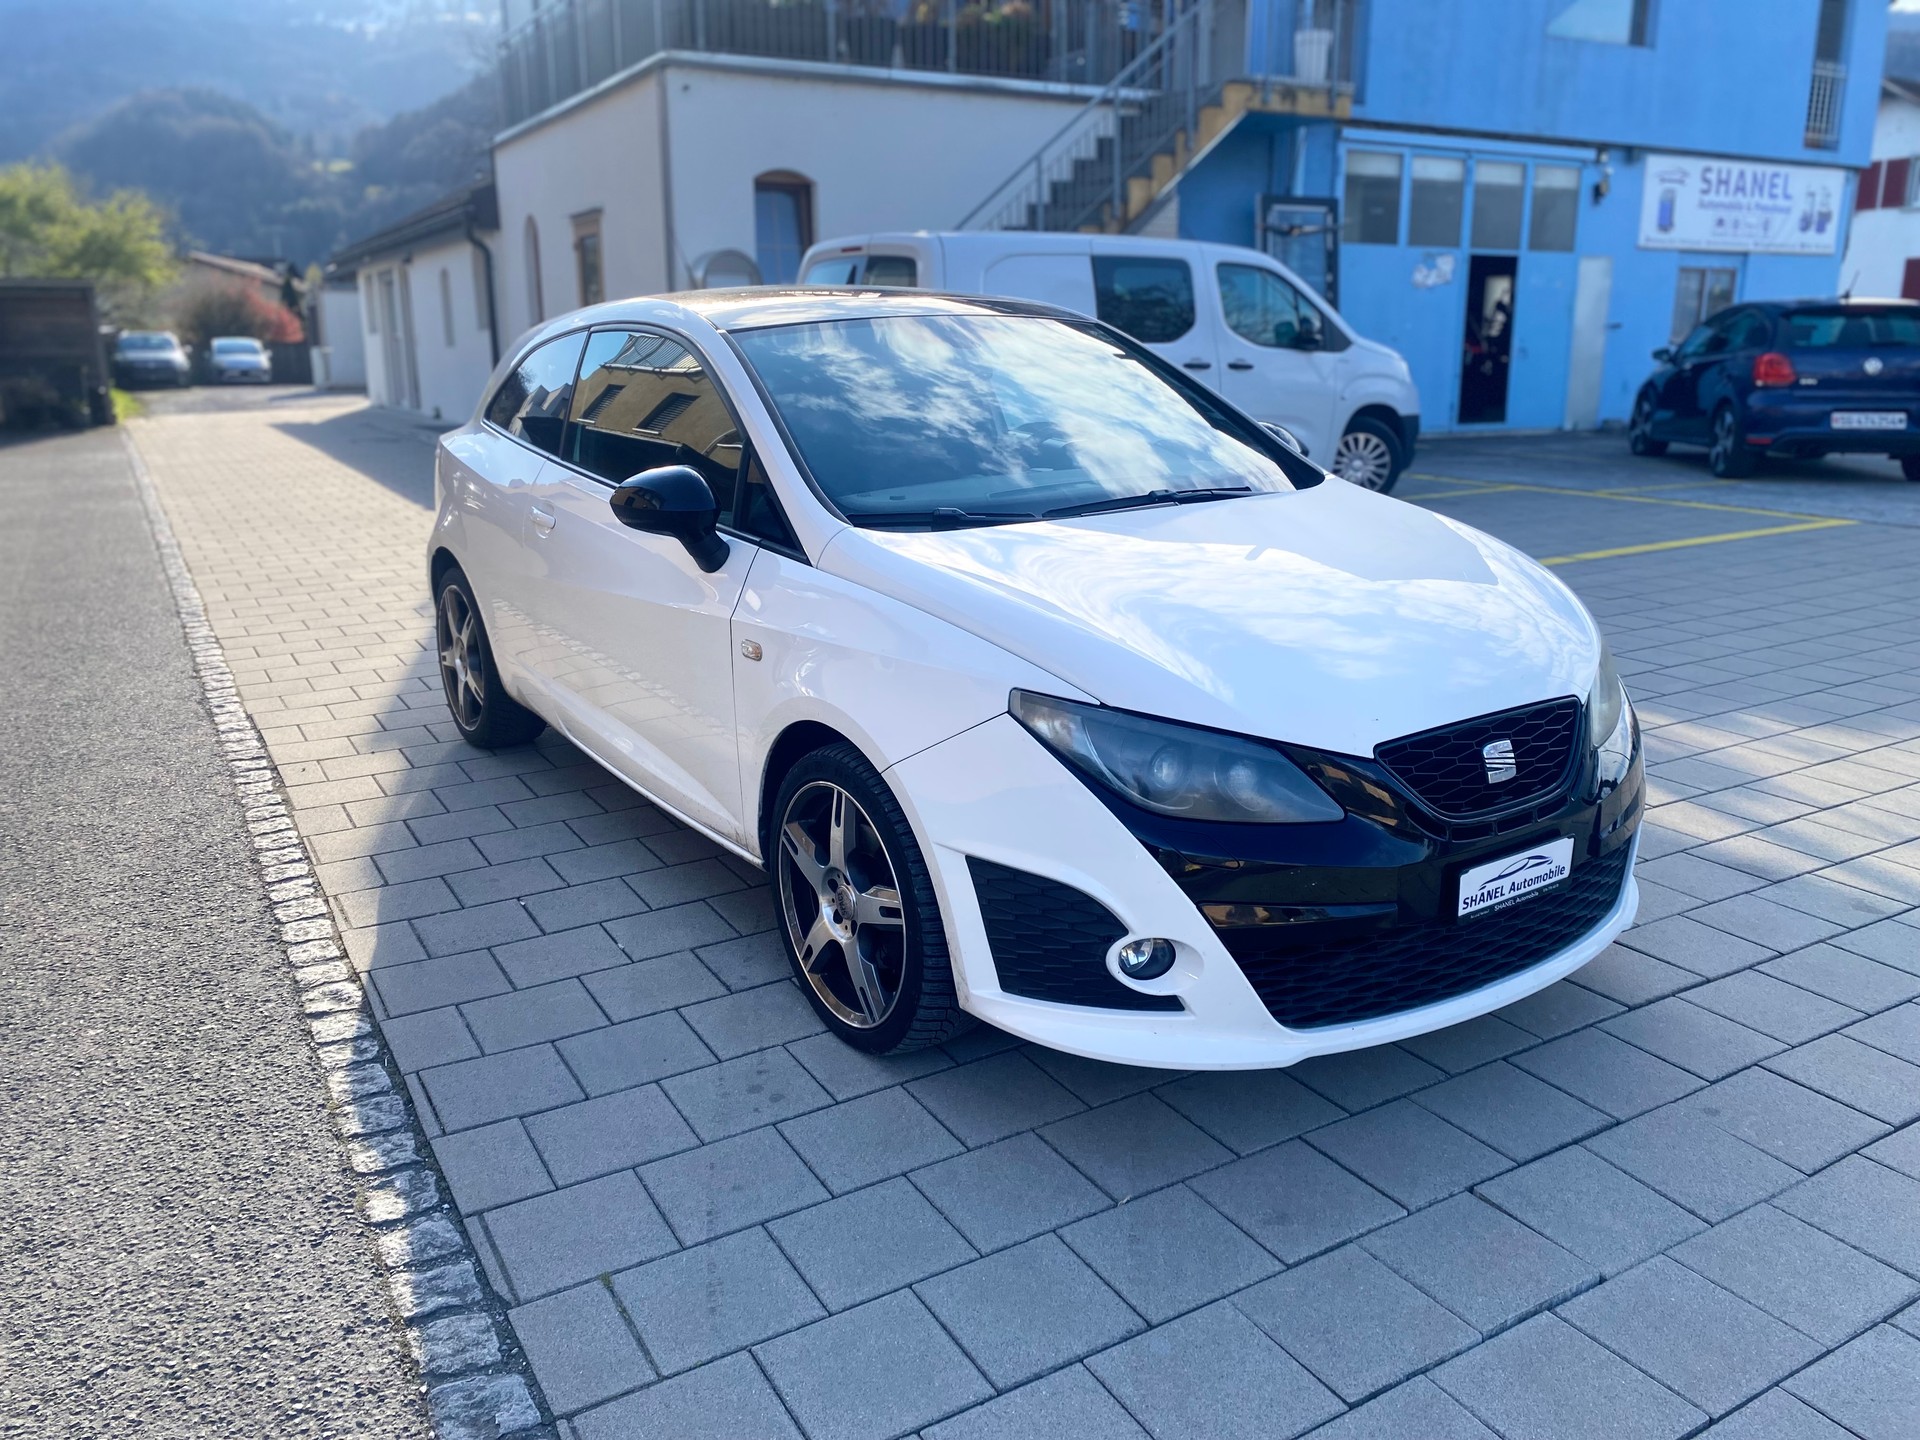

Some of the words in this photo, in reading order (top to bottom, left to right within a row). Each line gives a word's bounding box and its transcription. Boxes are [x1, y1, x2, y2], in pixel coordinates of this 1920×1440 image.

[1699, 165, 1793, 200] SHANEL
[1462, 885, 1506, 910] SHANEL
[1508, 865, 1566, 895] Automobile
[1494, 899, 1515, 912] SHANEL
